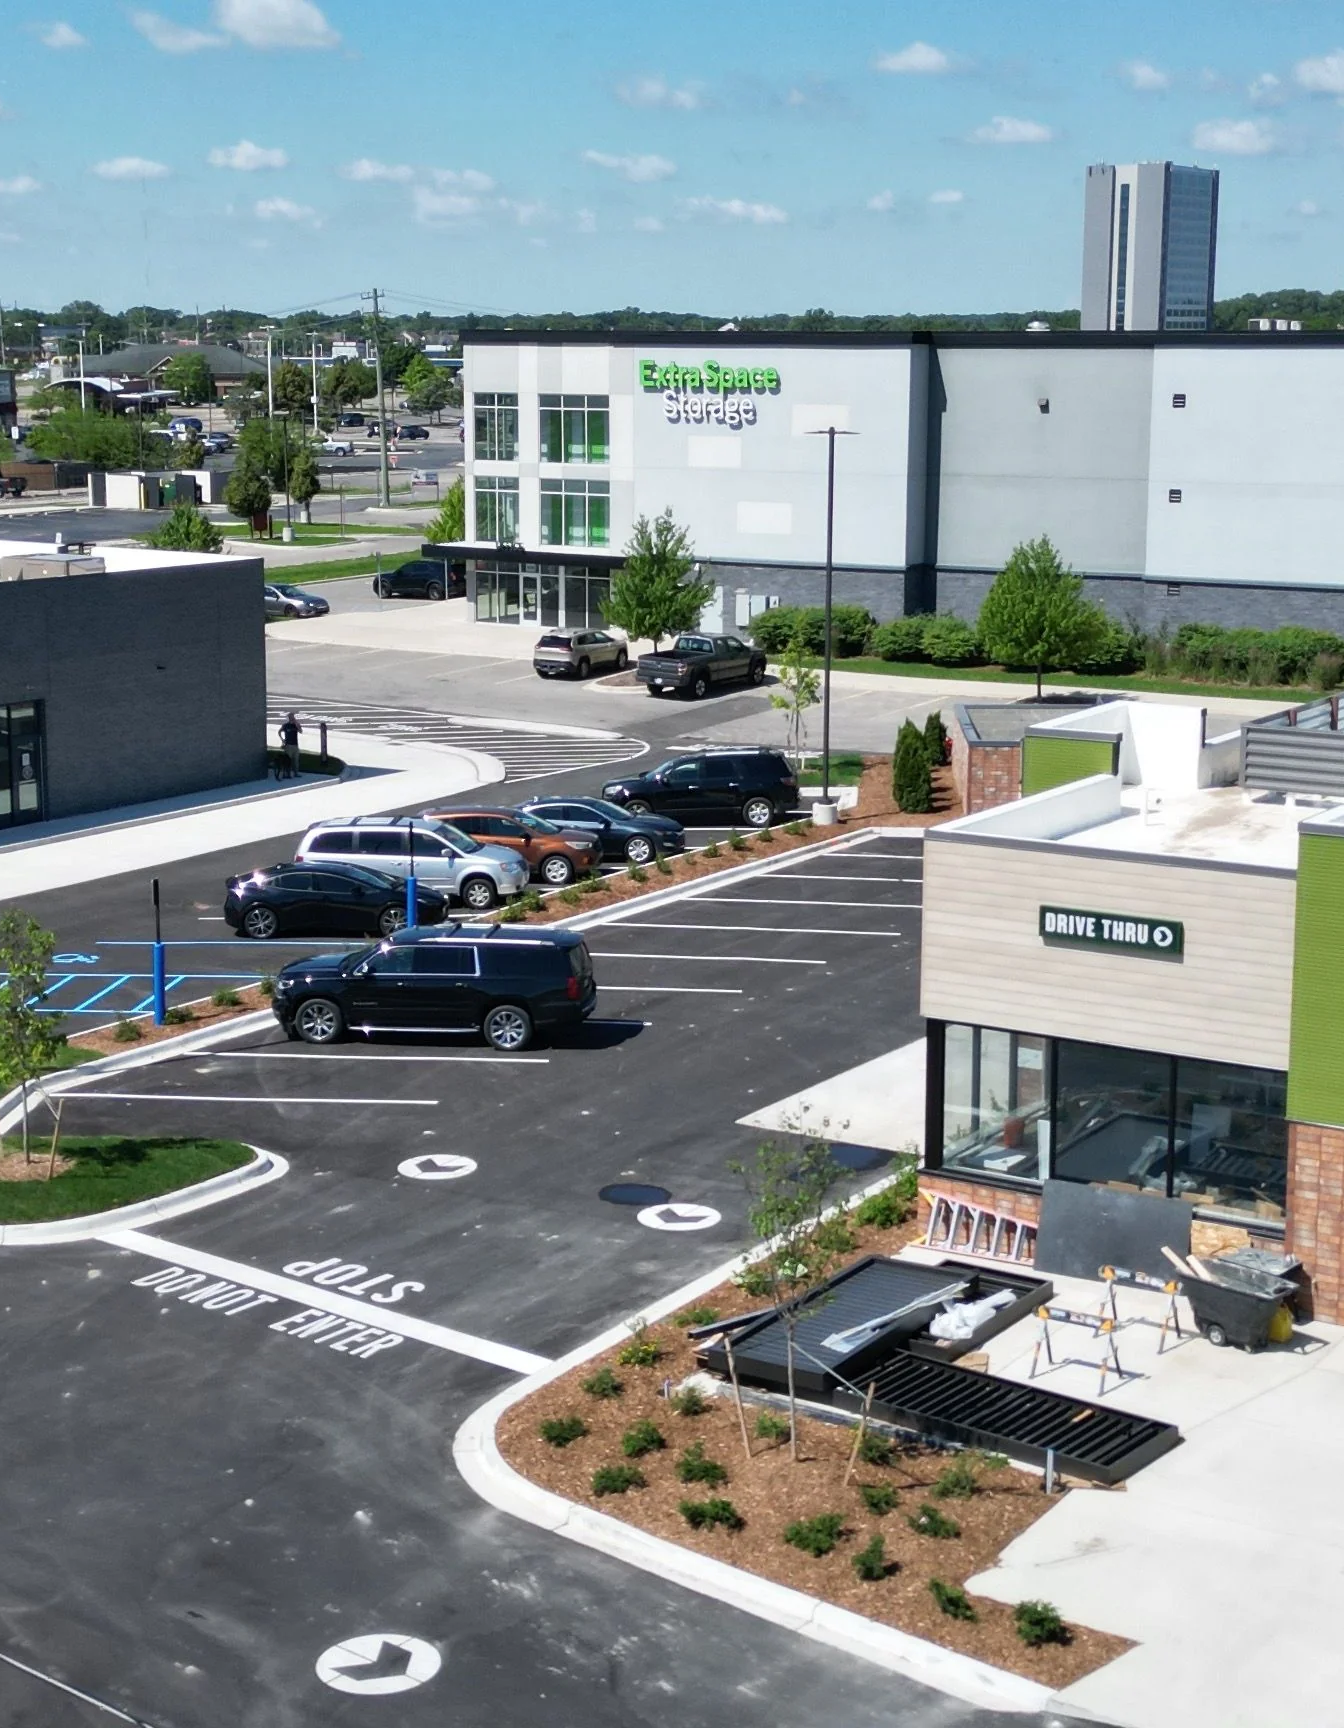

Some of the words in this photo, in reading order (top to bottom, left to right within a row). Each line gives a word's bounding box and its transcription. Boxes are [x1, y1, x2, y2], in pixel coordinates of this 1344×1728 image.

[639, 360, 700, 386] Extra
[703, 360, 778, 394] Space
[663, 390, 754, 425] Storage
[1044, 911, 1097, 938] DRIVE
[1101, 918, 1149, 945] THRU
[282, 1257, 426, 1303] STOP
[131, 1266, 207, 1294] DO
[178, 1281, 279, 1316] NOT
[268, 1308, 405, 1359] ENTER
